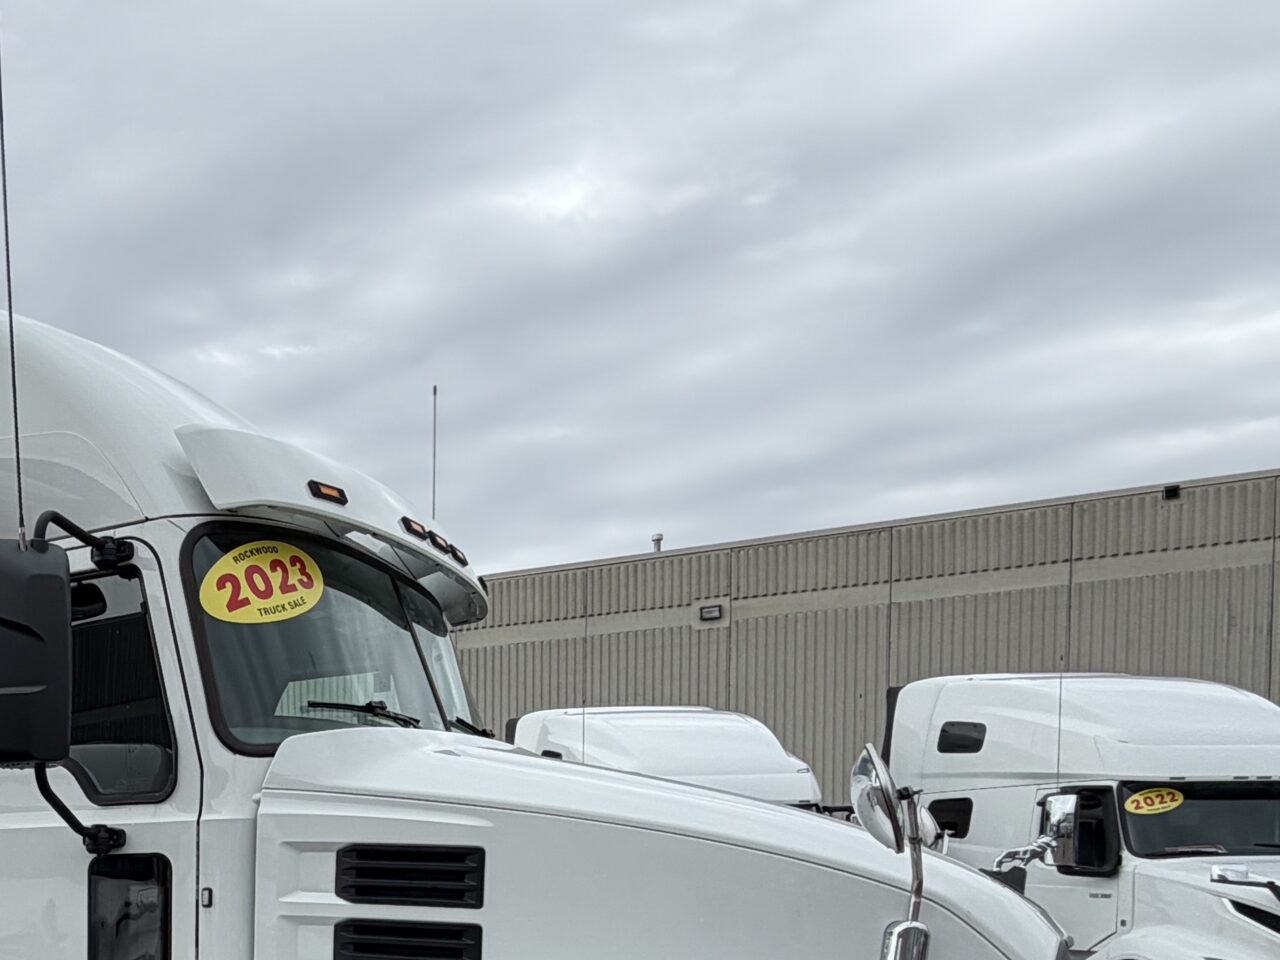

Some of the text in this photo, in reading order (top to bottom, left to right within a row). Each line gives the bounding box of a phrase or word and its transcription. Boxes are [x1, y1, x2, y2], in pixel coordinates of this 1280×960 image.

[232, 545, 279, 565] ROCKWOOD
[216, 555, 314, 613] 2023
[256, 596, 307, 617] TRUCK SALE
[1131, 791, 1179, 810] 2022
